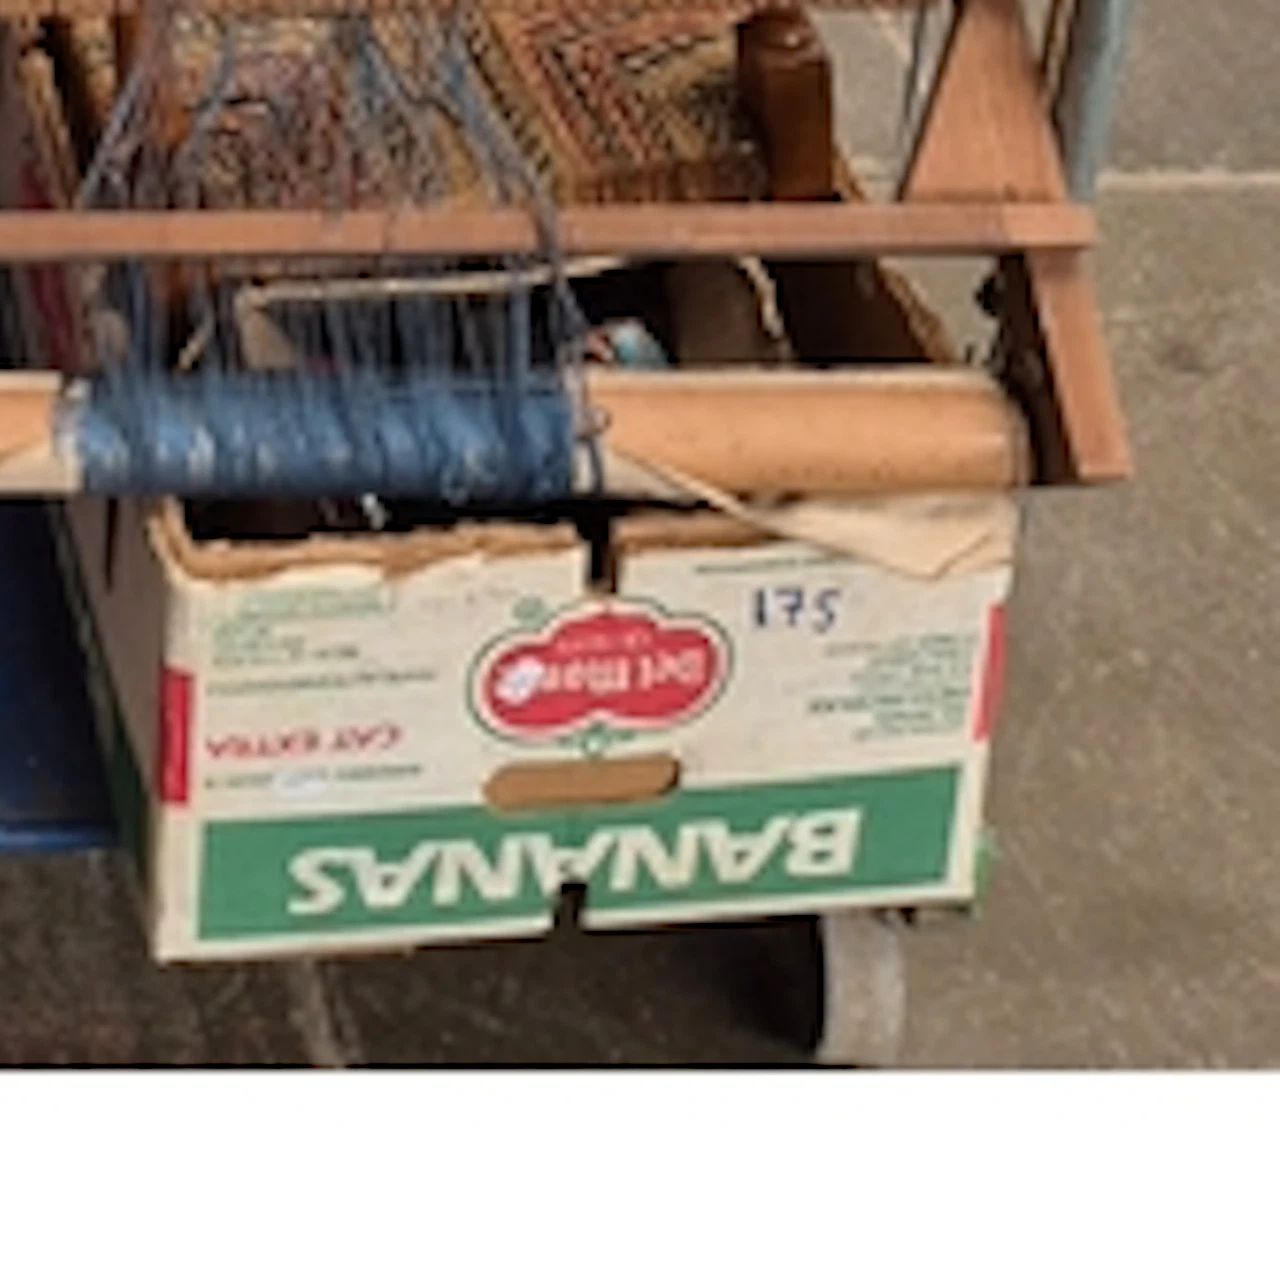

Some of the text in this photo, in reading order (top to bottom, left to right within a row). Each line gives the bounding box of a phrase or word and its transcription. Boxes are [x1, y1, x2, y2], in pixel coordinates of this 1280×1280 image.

[752, 587, 842, 634] 175
[205, 729, 321, 760] EXTRA
[286, 807, 863, 916] BANANAS
